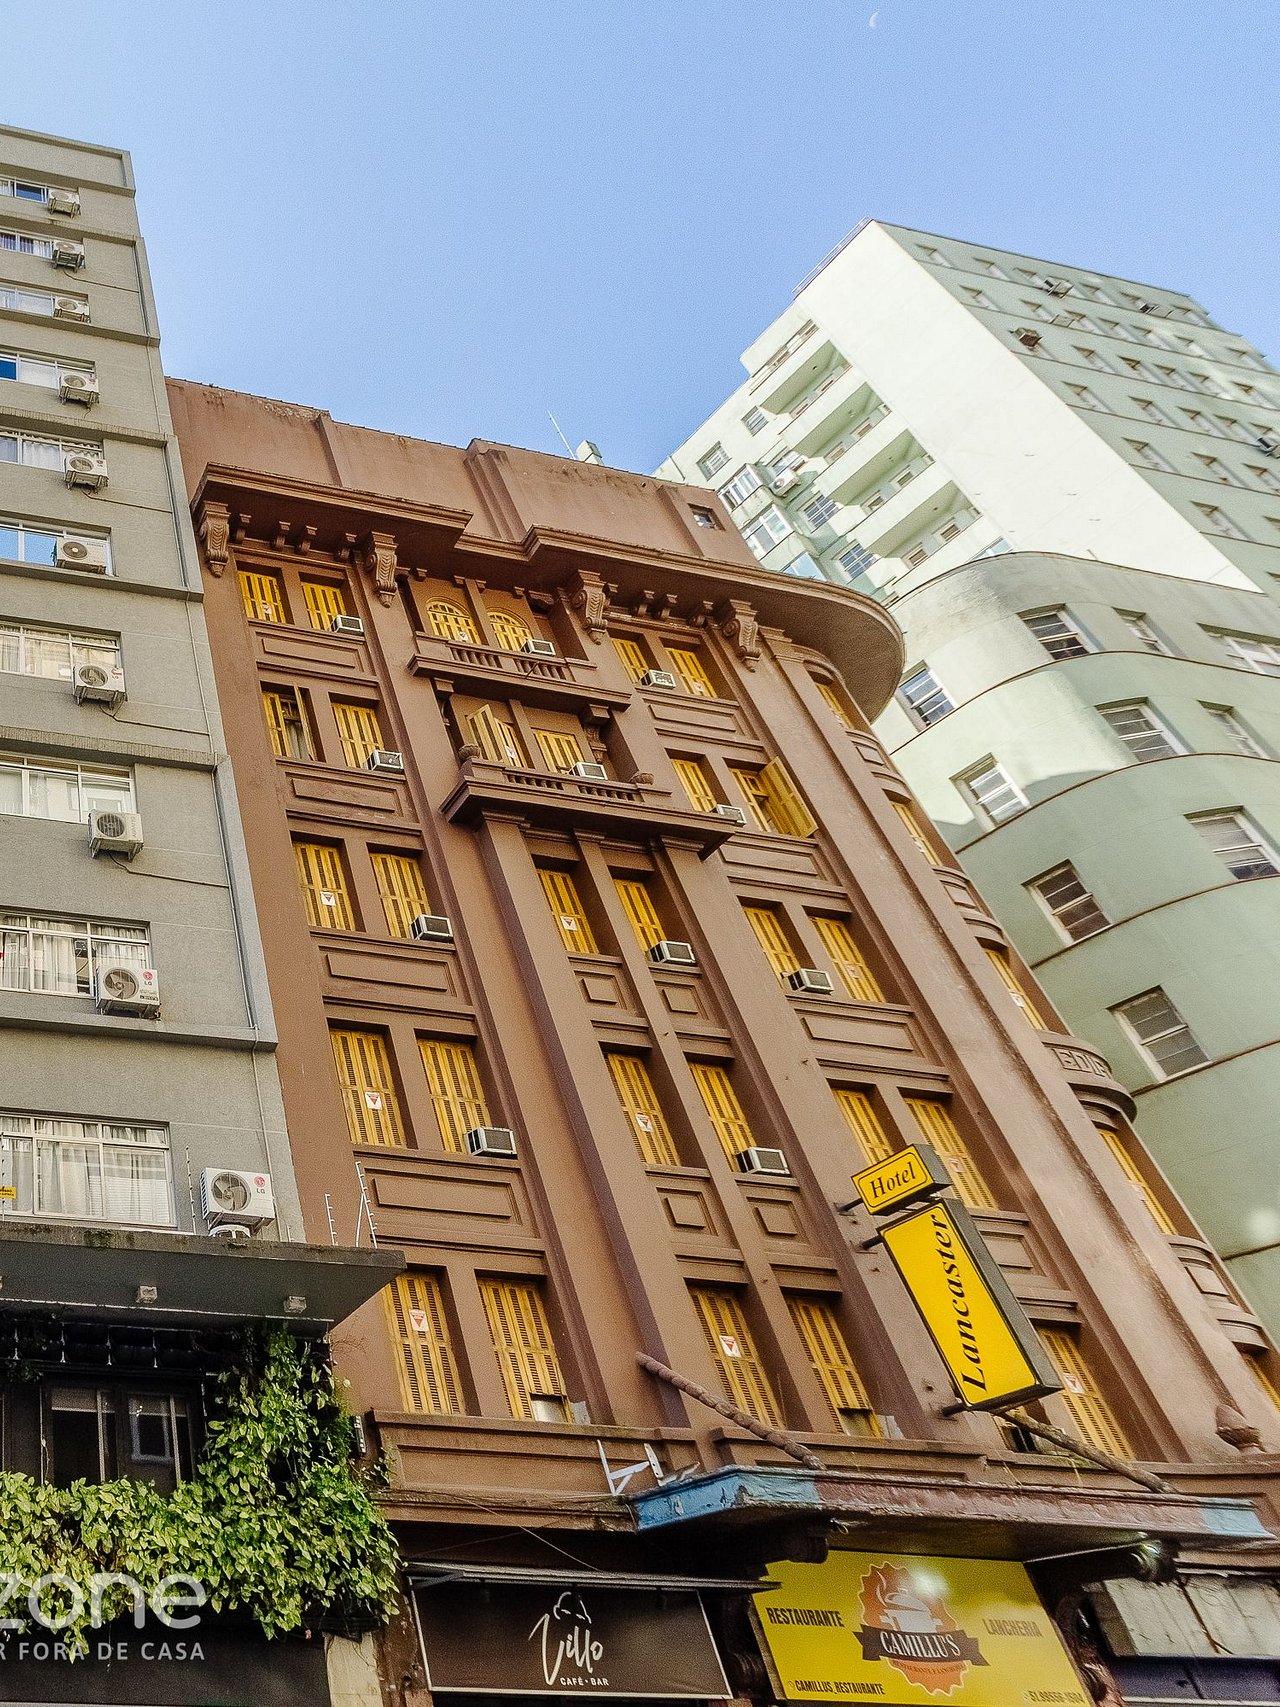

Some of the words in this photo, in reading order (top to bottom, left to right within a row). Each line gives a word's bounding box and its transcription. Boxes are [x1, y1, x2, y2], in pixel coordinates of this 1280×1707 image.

[869, 1161, 917, 1200] Hotel
[930, 1213, 988, 1393] Lancaster
[766, 1607, 845, 1628] RESTAURANTE
[982, 1619, 1044, 1637] LANCHERIA
[880, 1631, 961, 1658] CAMILLU'S
[591, 1678, 610, 1686] BAR
